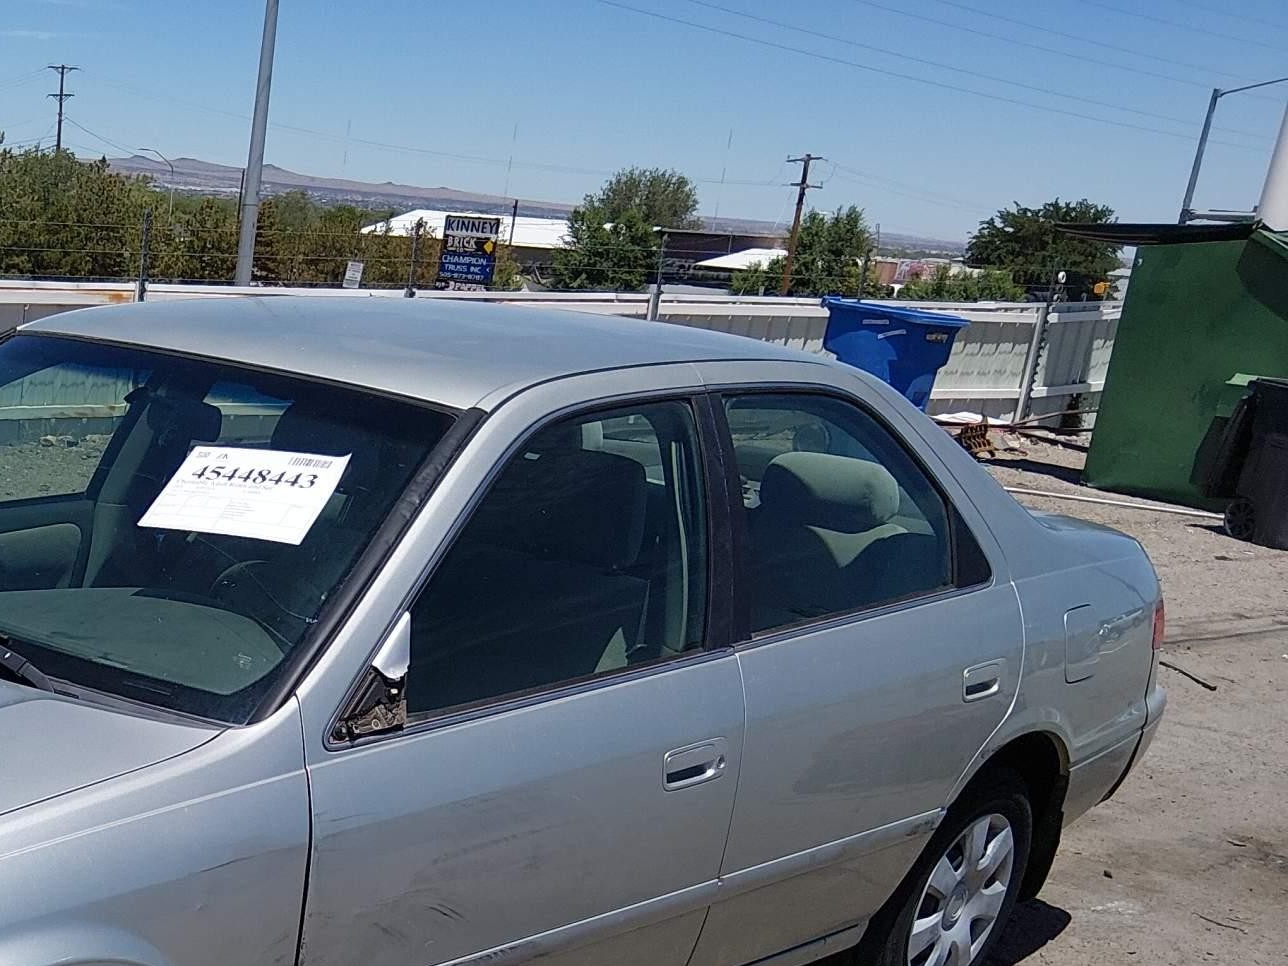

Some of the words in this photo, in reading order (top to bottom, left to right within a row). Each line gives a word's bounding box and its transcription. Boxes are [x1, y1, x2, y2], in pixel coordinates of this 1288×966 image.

[447, 218, 497, 233] KINNEY
[447, 236, 477, 249] BRICK
[442, 255, 486, 266] CHAMPION
[444, 264, 467, 272] TRUSS
[469, 266, 482, 274] INC
[192, 464, 319, 489] 45448443
